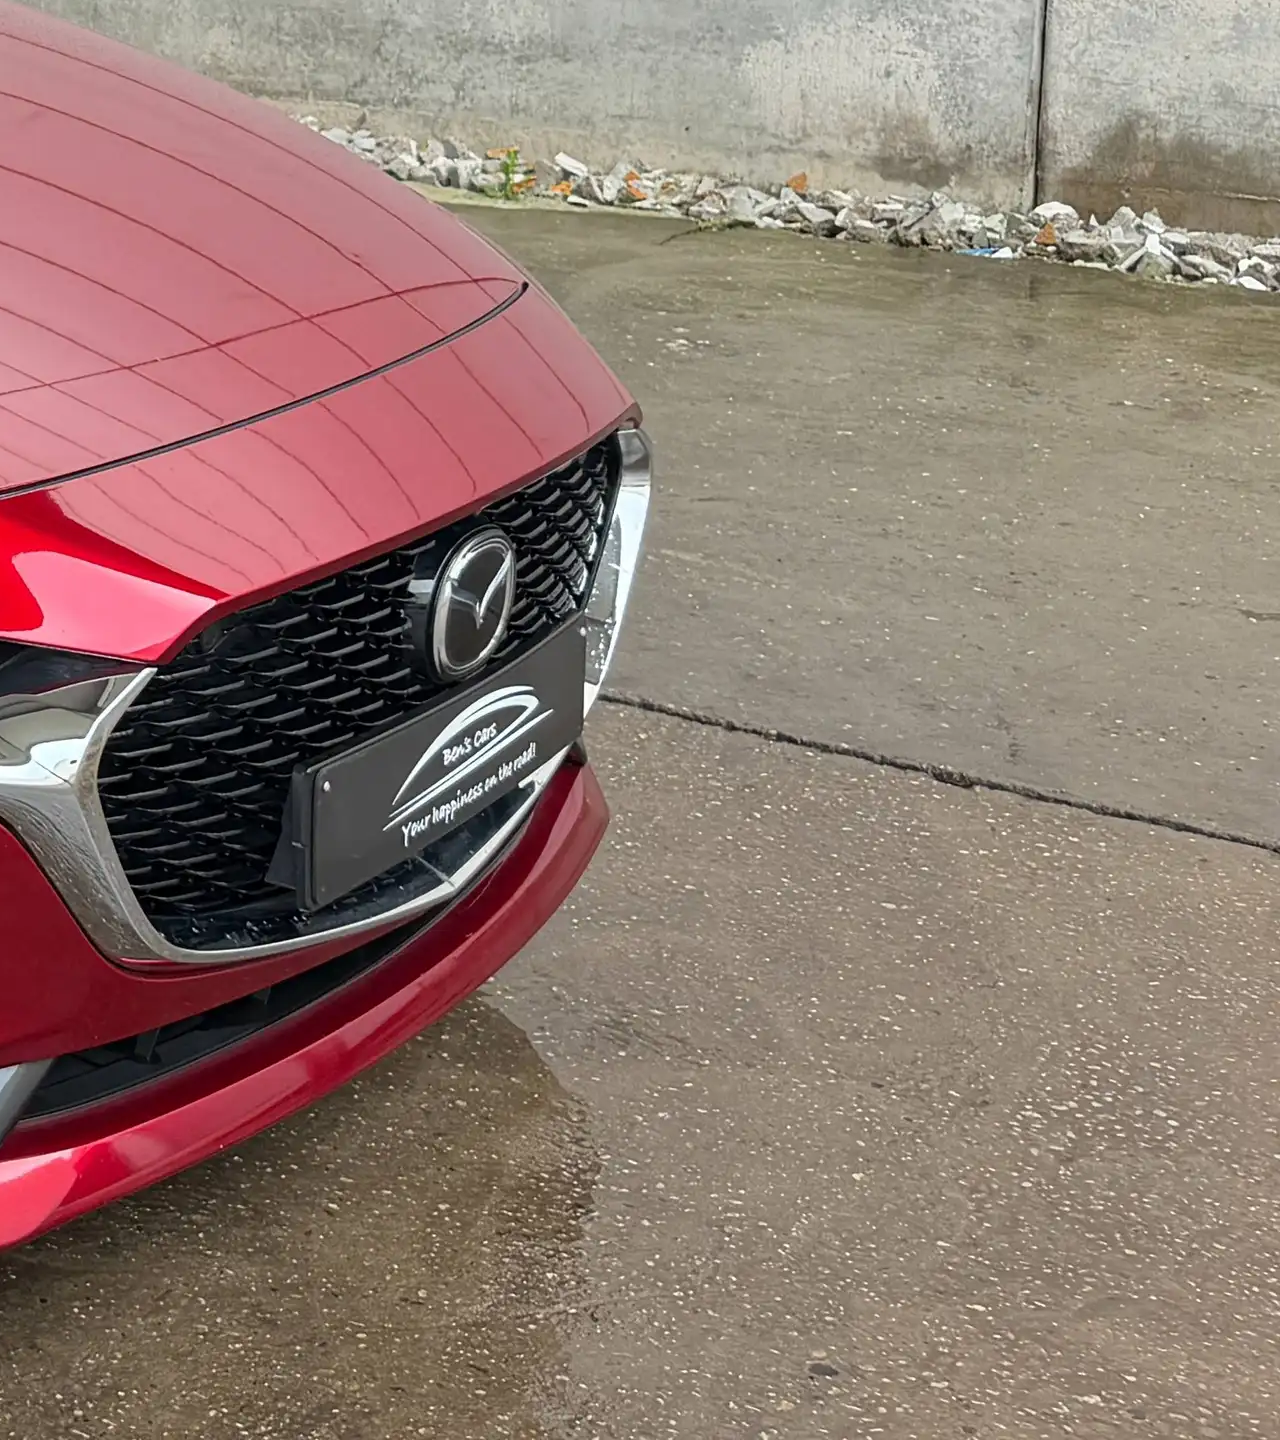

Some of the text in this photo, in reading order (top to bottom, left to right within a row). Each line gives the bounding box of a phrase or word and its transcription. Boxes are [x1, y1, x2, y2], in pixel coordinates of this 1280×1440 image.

[442, 722, 498, 766] Ben's Cars
[401, 813, 431, 847] Your
[432, 781, 483, 824] happiness
[484, 774, 498, 793] on
[498, 761, 514, 782] the
